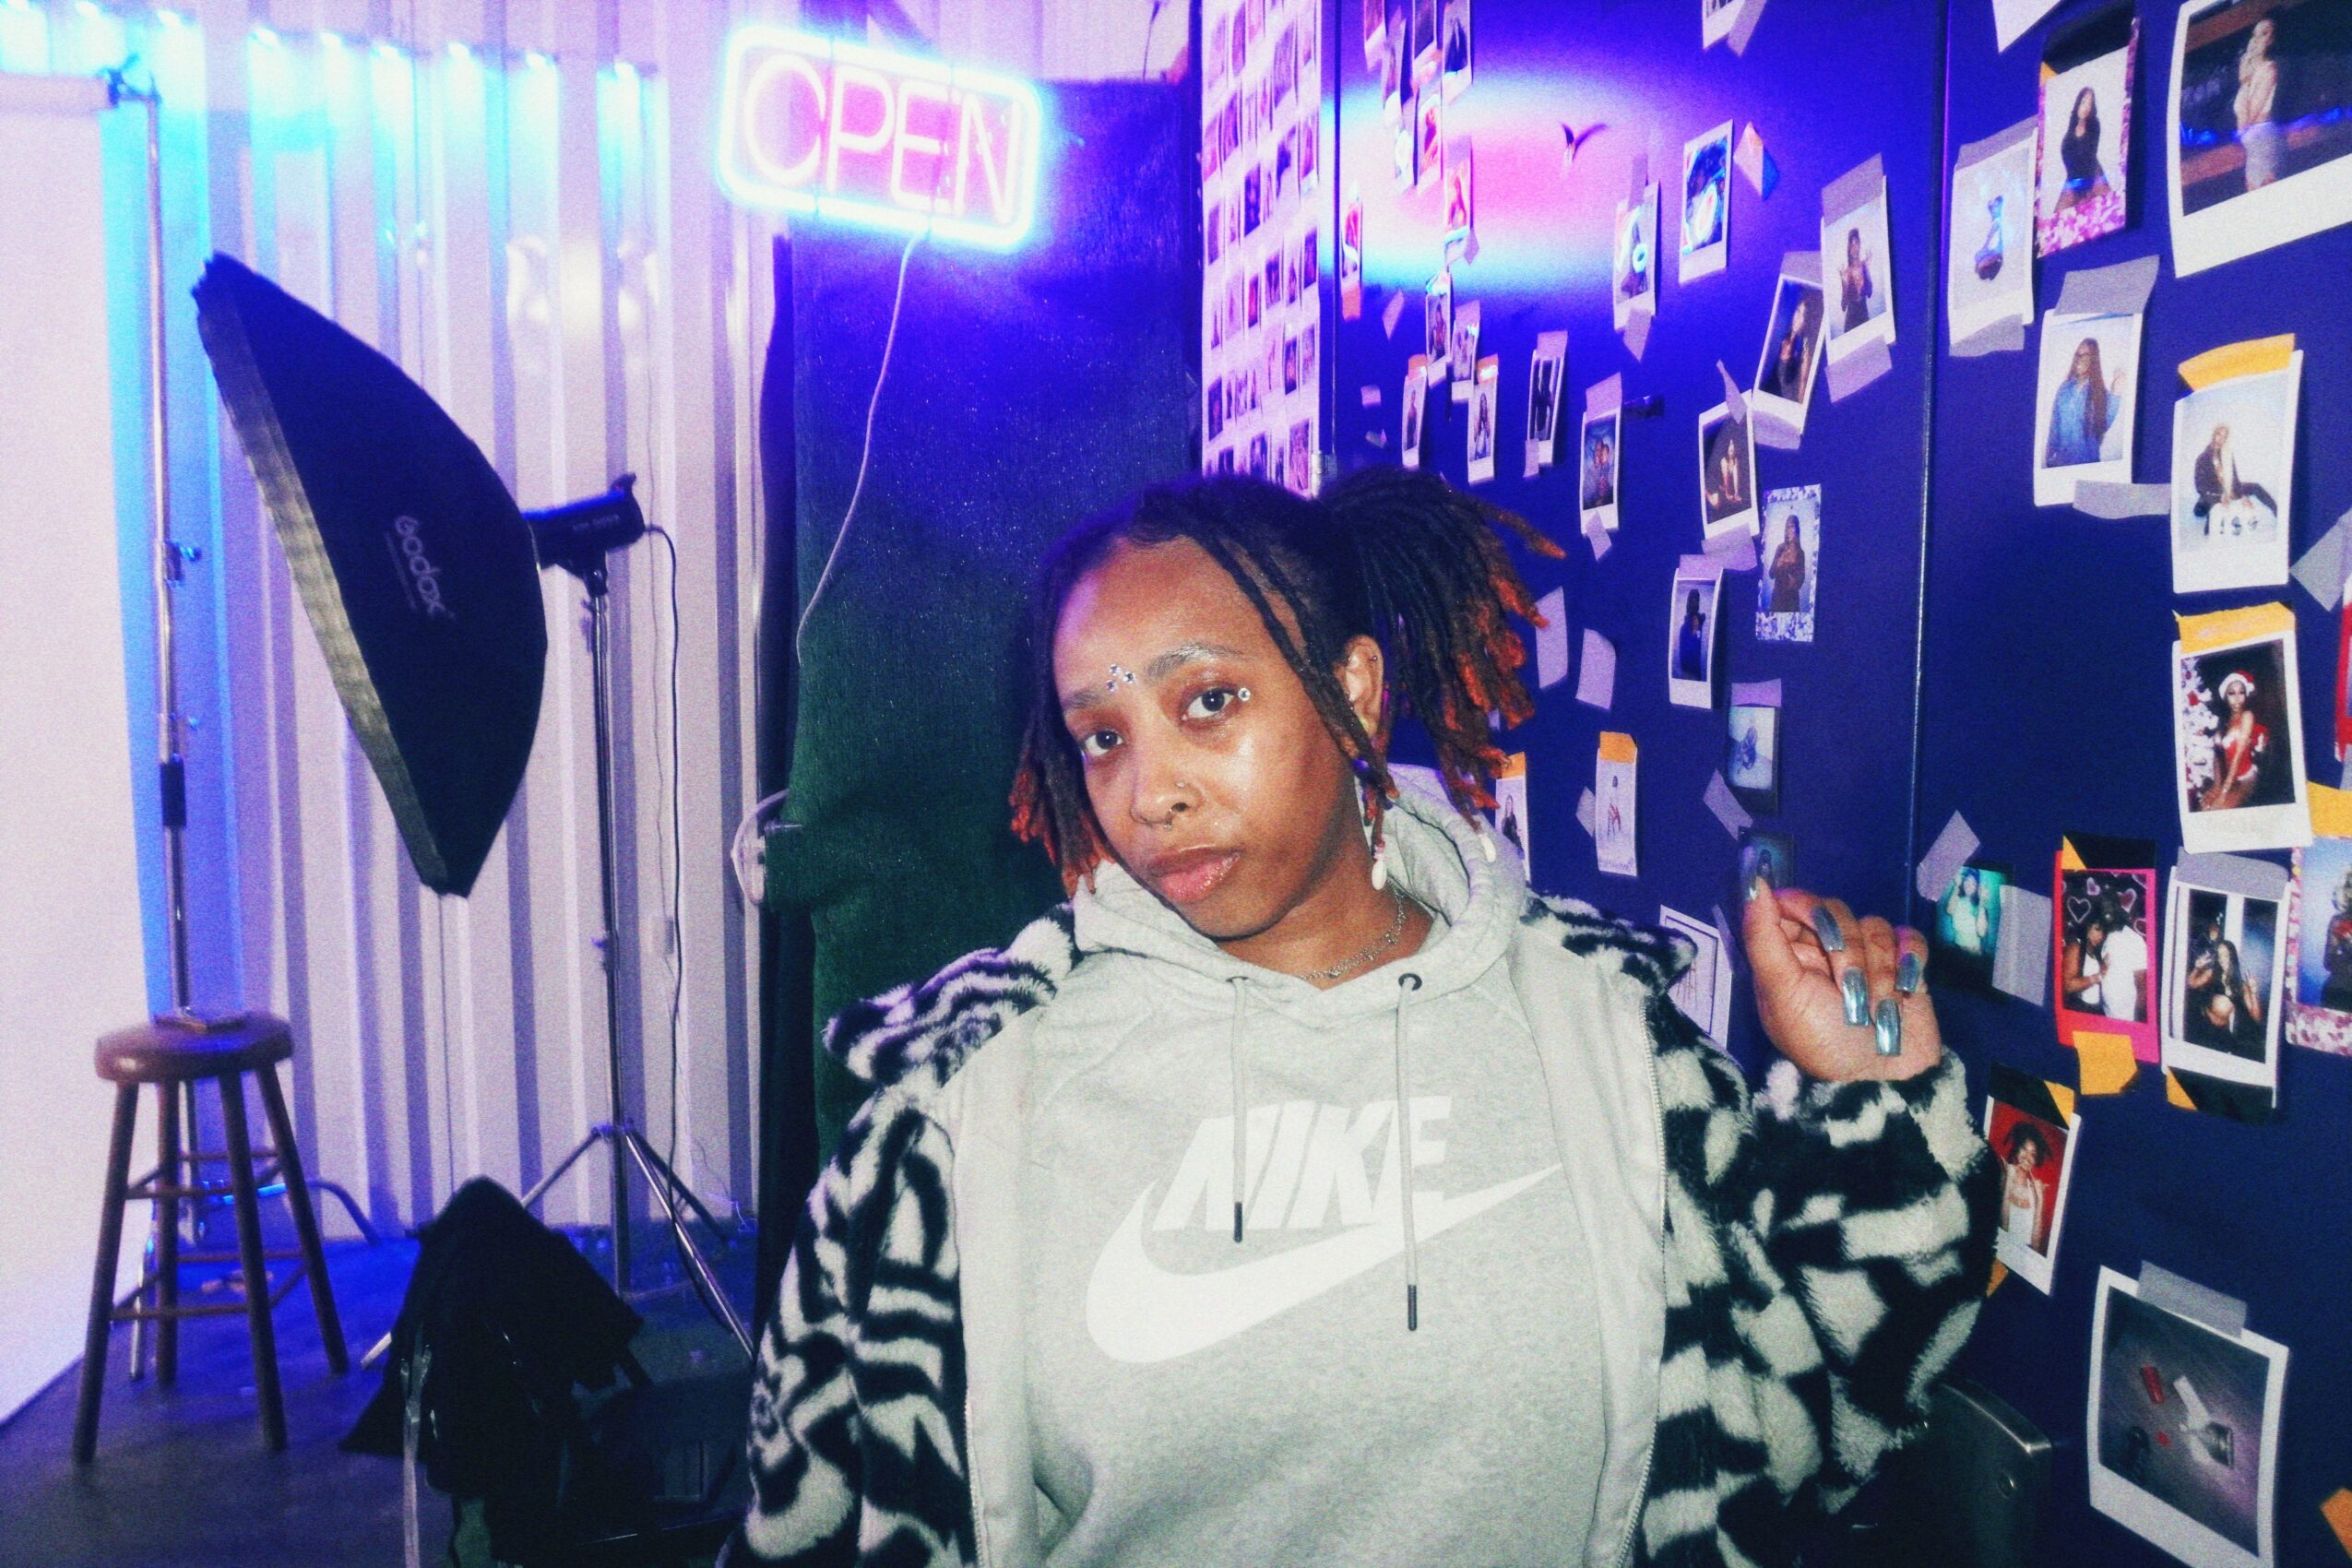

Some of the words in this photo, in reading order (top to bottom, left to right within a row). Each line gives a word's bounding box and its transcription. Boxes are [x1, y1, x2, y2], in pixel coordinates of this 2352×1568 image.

[742, 52, 1023, 226] OPEN
[394, 515, 456, 617] Godox
[1150, 1095, 1453, 1232] NIKE
